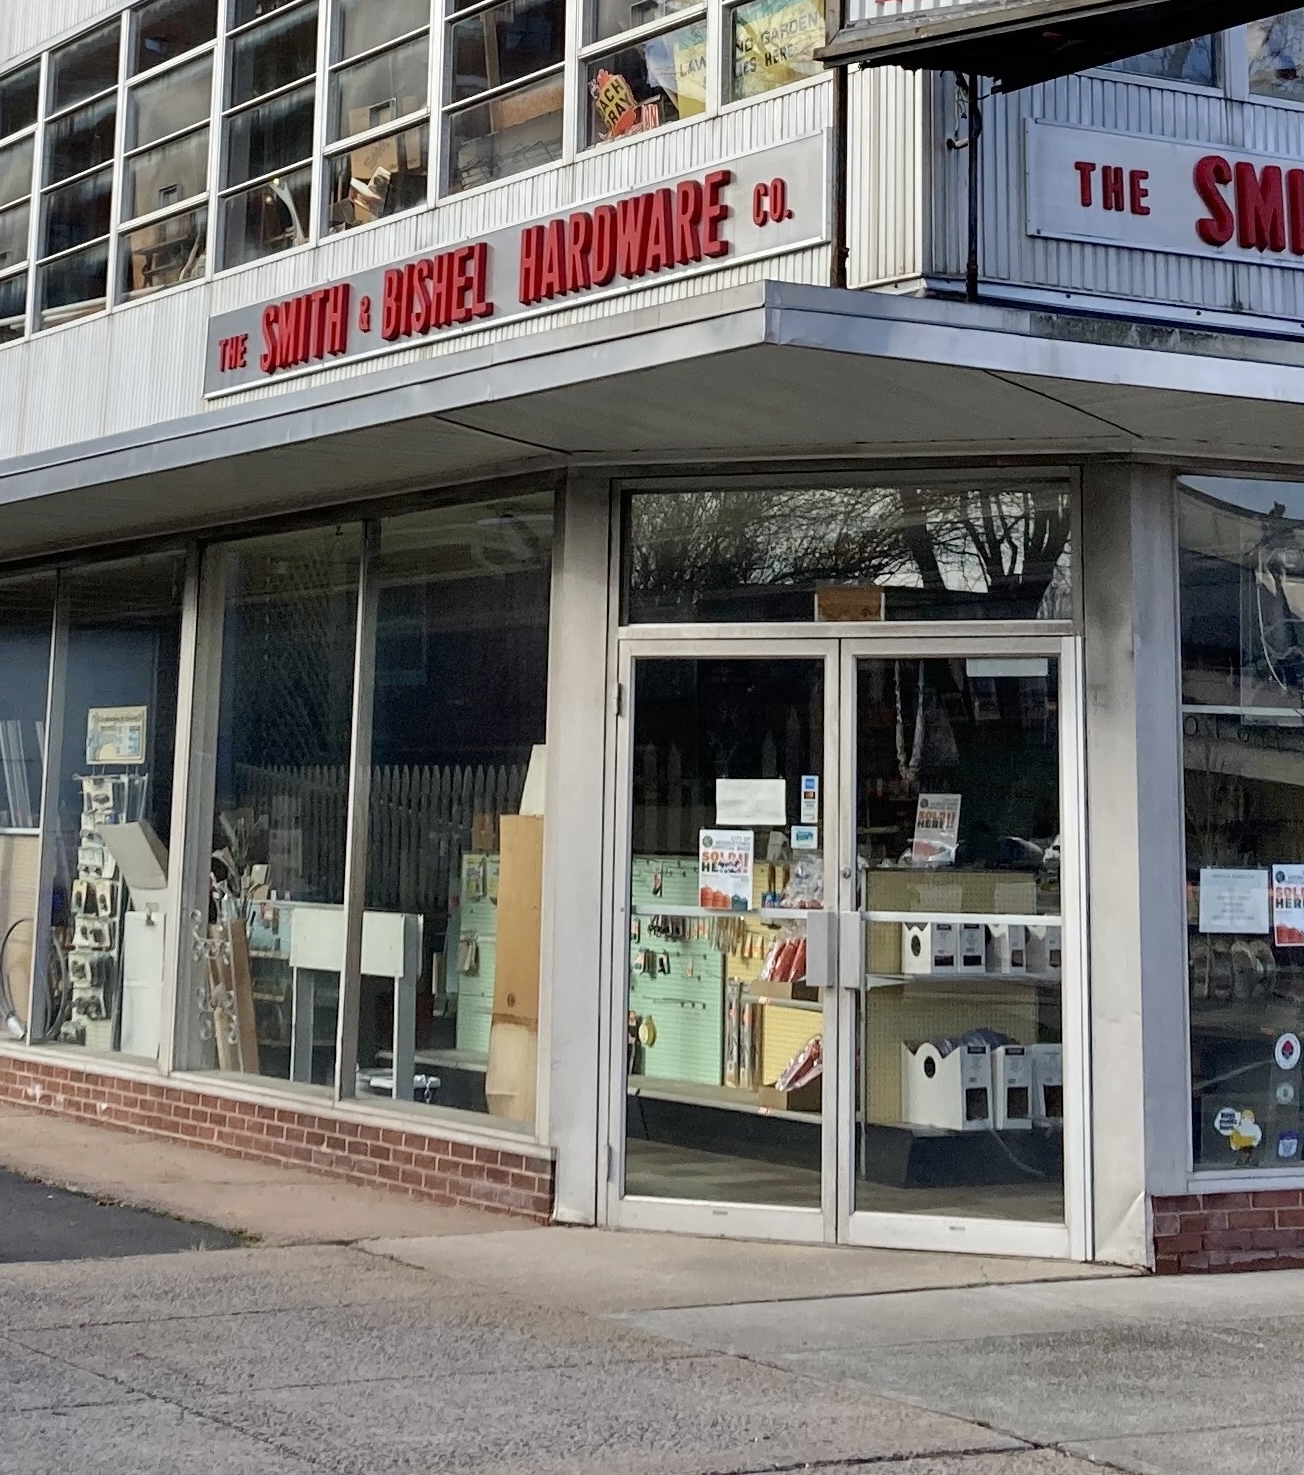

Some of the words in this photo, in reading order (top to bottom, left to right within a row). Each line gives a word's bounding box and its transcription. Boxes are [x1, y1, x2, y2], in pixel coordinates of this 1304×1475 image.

[761, 12, 818, 45] GARDEN
[599, 78, 624, 114] ACH
[1074, 161, 1151, 216] THE
[218, 332, 249, 373] THE
[259, 283, 351, 375] SMITH
[358, 295, 371, 333] &
[381, 242, 495, 342] BISHEL
[518, 169, 732, 307] HARDWARE
[753, 177, 794, 227] CO.
